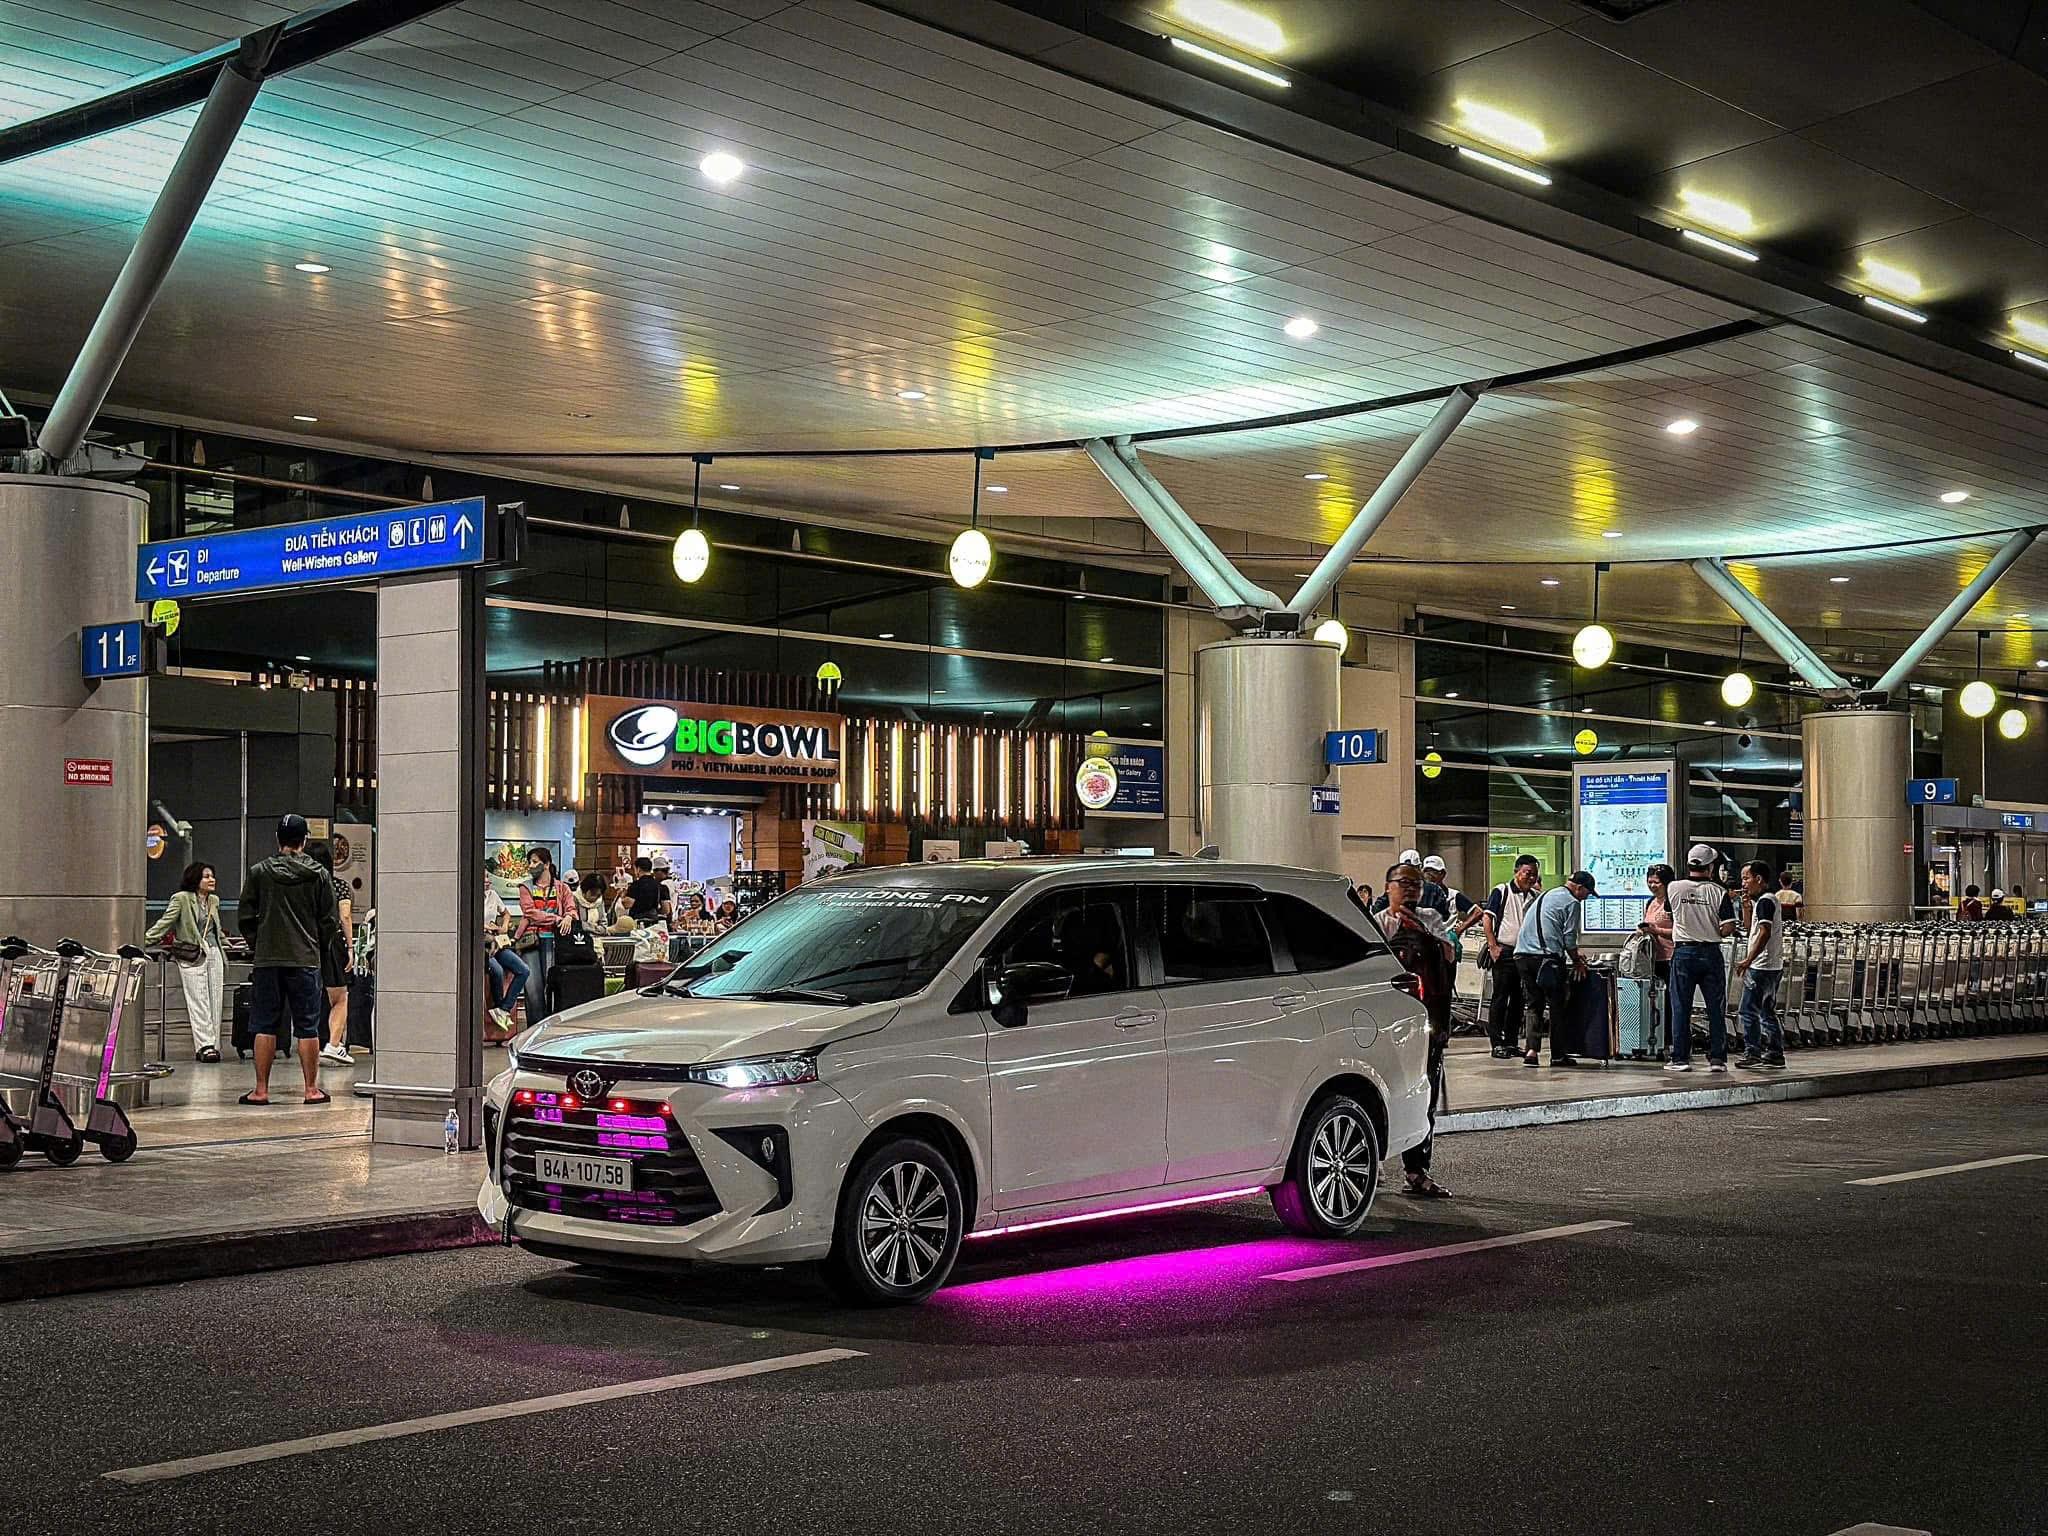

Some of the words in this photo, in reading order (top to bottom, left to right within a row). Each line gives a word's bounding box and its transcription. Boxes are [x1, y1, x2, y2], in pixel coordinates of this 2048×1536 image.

[285, 534, 309, 553] ĐƯA
[311, 526, 336, 549] TIỄN
[339, 525, 379, 546] KHÁCH
[197, 548, 209, 564] ĐI
[281, 554, 342, 573] Well-Wishers
[344, 550, 378, 565] Gallery
[196, 568, 240, 585] Departure
[98, 629, 125, 669] 11
[127, 654, 137, 666] 2F
[1338, 734, 1363, 759] 10
[80, 773, 110, 781] SMOKING
[703, 761, 767, 775] VIETNAMESE
[769, 765, 809, 777] NOODLE
[811, 767, 838, 778] SOUP
[1924, 782, 1937, 800] 9
[940, 893, 990, 904] AN
[543, 1158, 624, 1185] 84A-107.58
